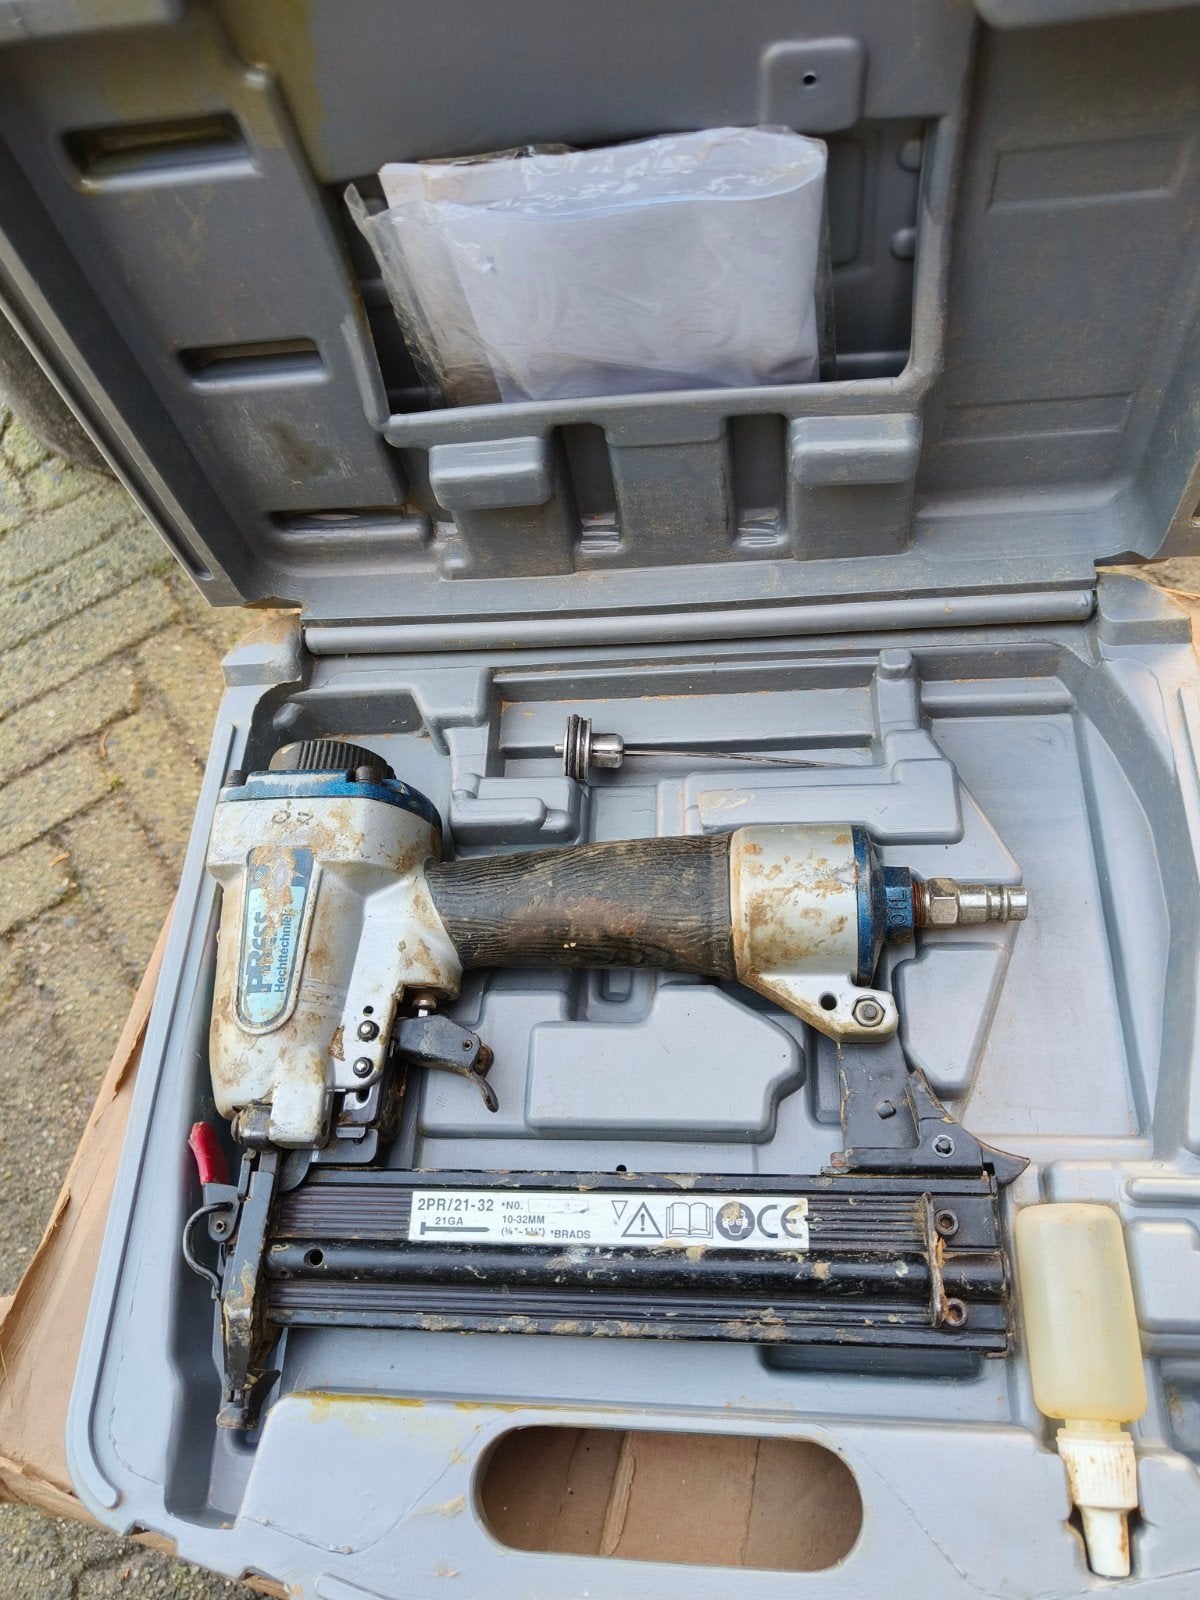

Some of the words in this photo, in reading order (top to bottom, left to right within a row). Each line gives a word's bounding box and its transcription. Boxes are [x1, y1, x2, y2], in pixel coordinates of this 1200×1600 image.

[889, 889, 908, 926] OIL
[417, 1197, 494, 1213] 2PR/21-32
[435, 1217, 464, 1226] 21GA
[502, 1215, 545, 1224] 10-32MM
[756, 1204, 803, 1239] CE
